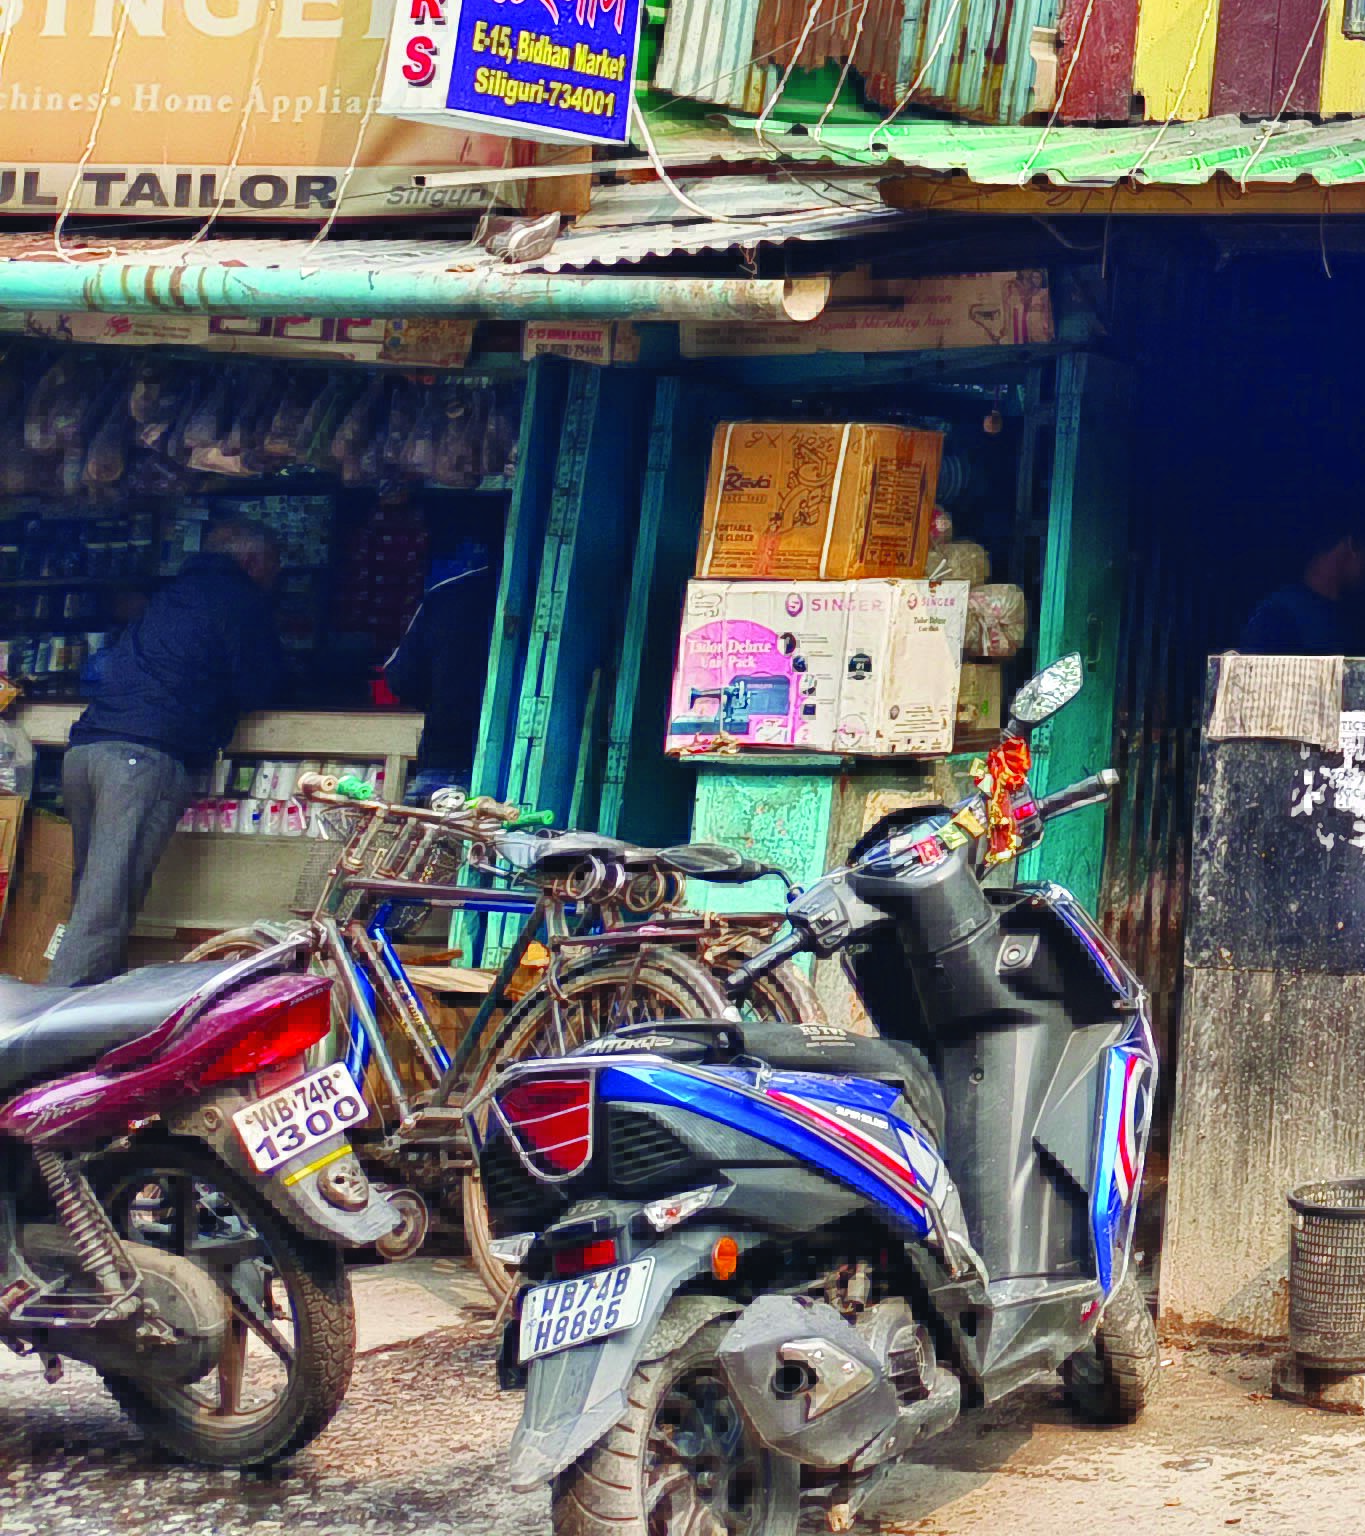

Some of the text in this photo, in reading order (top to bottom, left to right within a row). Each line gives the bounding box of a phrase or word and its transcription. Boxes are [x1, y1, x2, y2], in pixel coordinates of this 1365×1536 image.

[517, 30, 572, 71] Bidhan
[574, 42, 628, 83] Market
[134, 84, 233, 114] Home
[473, 66, 615, 118] Siliguri-734001
[79, 172, 338, 210] TAILOR
[811, 599, 884, 612] SINGER
[255, 1095, 361, 1161] 1300
[534, 1299, 622, 1353] H8895
